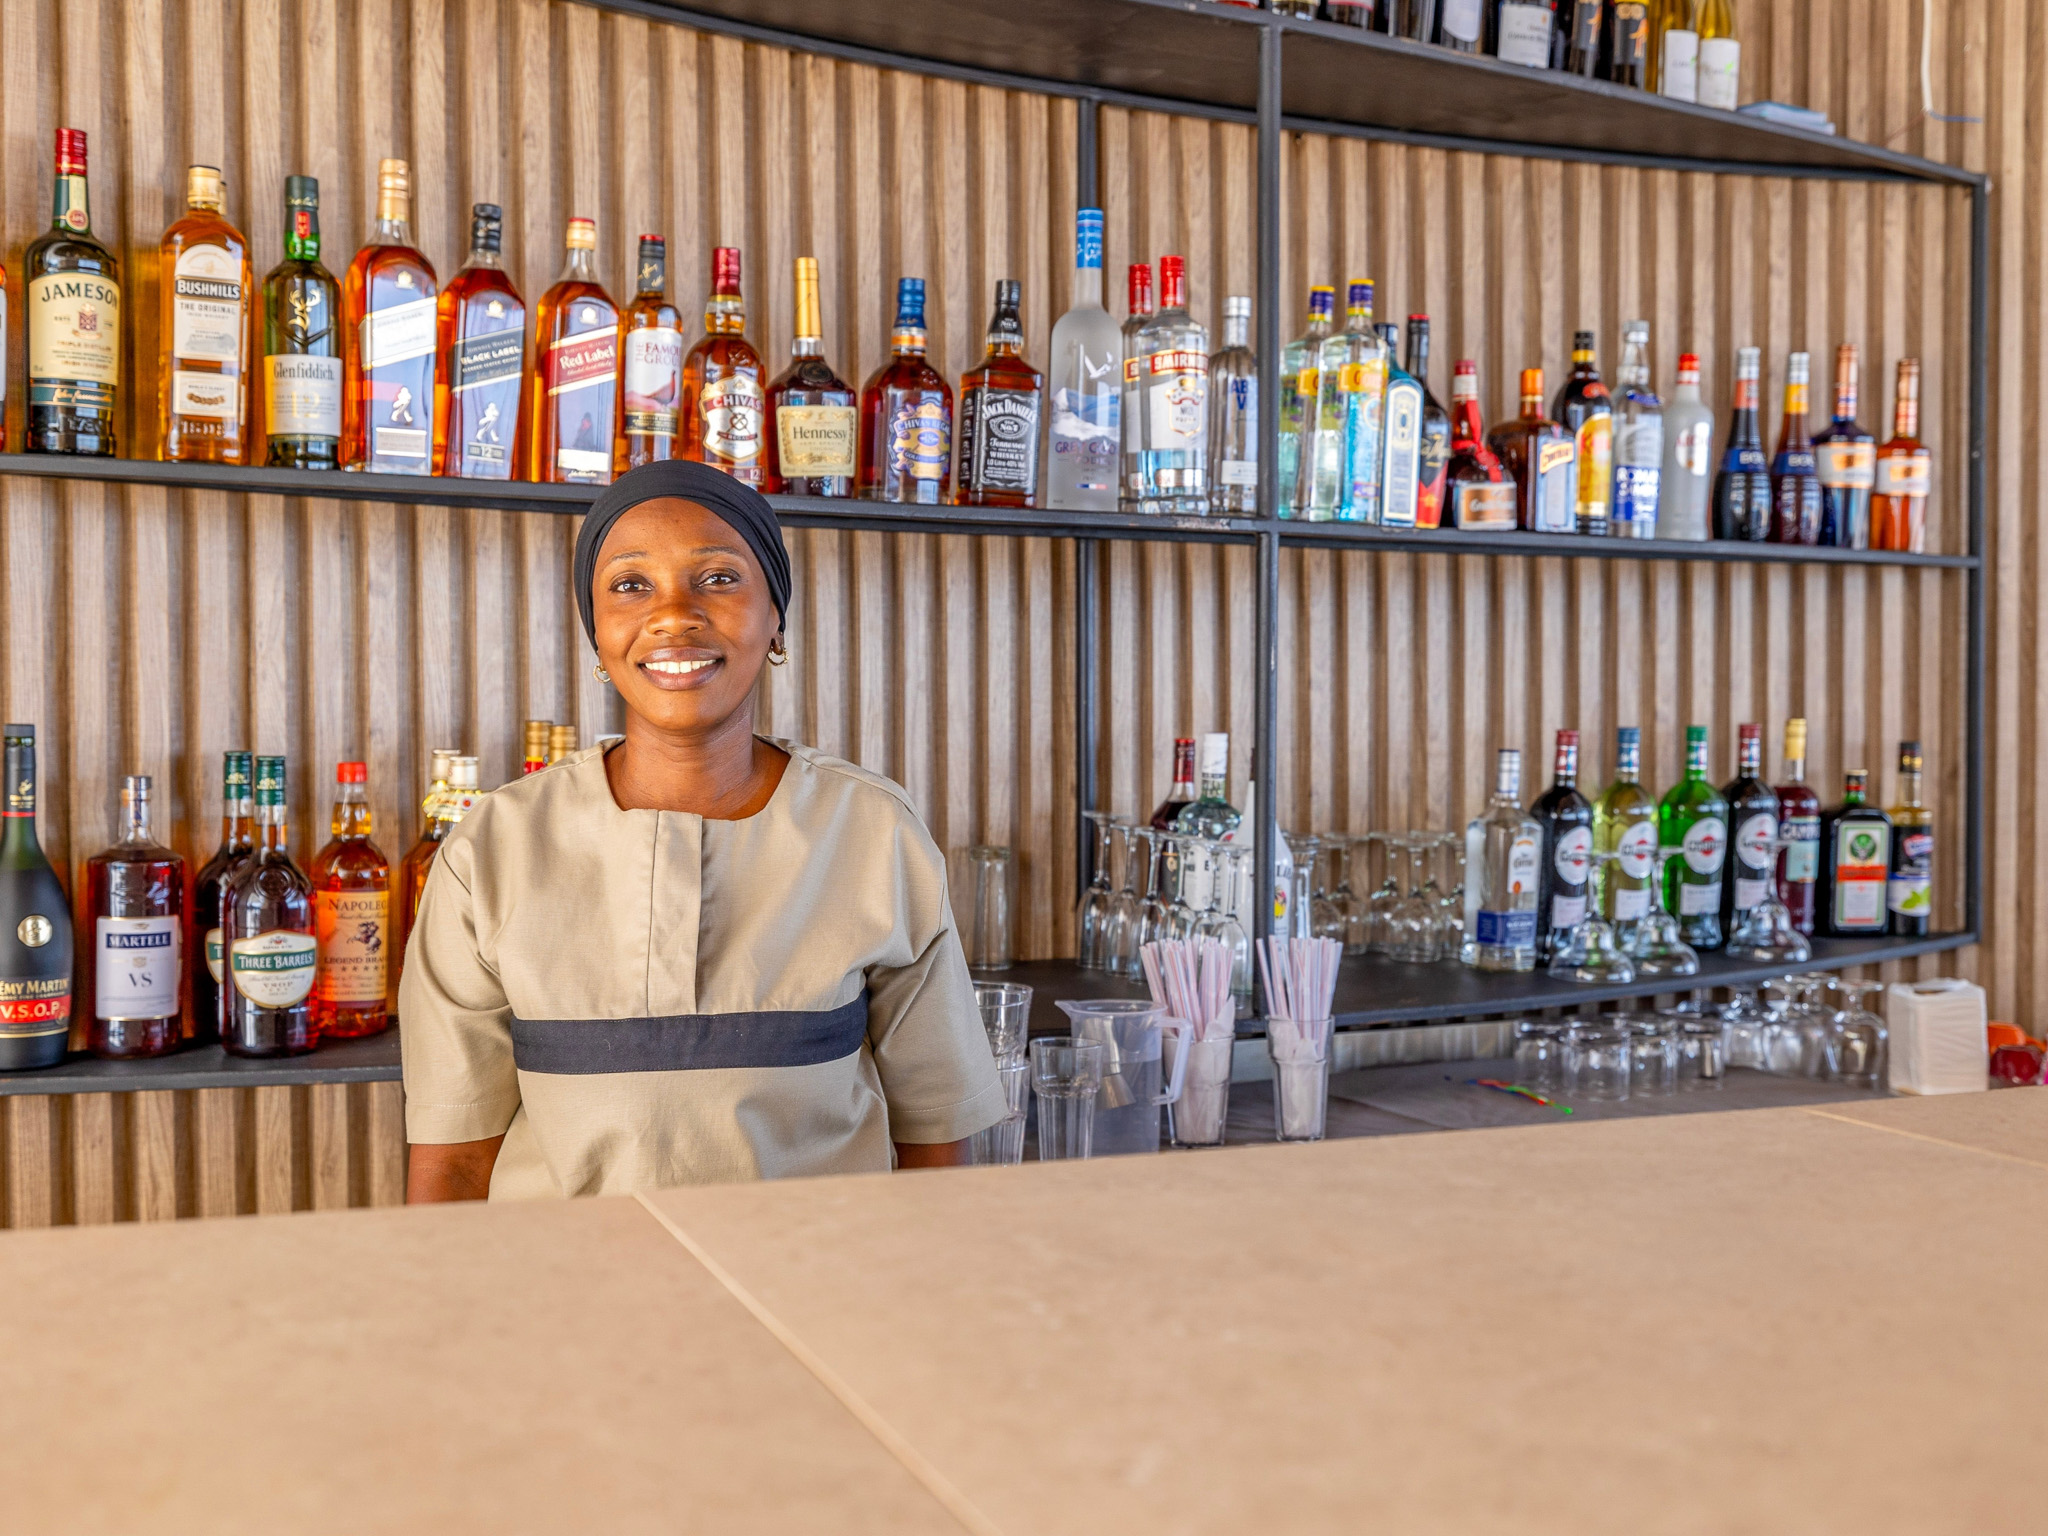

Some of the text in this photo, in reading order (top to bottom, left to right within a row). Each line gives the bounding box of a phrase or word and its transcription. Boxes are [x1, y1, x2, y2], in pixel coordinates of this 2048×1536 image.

[177, 279, 240, 299] BUSHMILLS
[179, 303, 236, 315] THE ORIGINAL
[460, 351, 491, 366] BLACK
[560, 352, 585, 370] Red
[584, 344, 616, 364] Label
[712, 393, 763, 411] CHIVAS
[981, 401, 1004, 420] JACK
[793, 425, 848, 442] Hennessy
[989, 437, 1026, 450] Tennessee
[1055, 441, 1087, 454] GREY
[989, 451, 1025, 461] WHISKEY
[749, 467, 761, 480] 12
[109, 934, 169, 948] MARTELL
[239, 951, 314, 970] THREE BARRELS
[324, 956, 363, 965] LEGEND
[26, 977, 69, 995] MARTIN
[129, 972, 153, 988] VS
